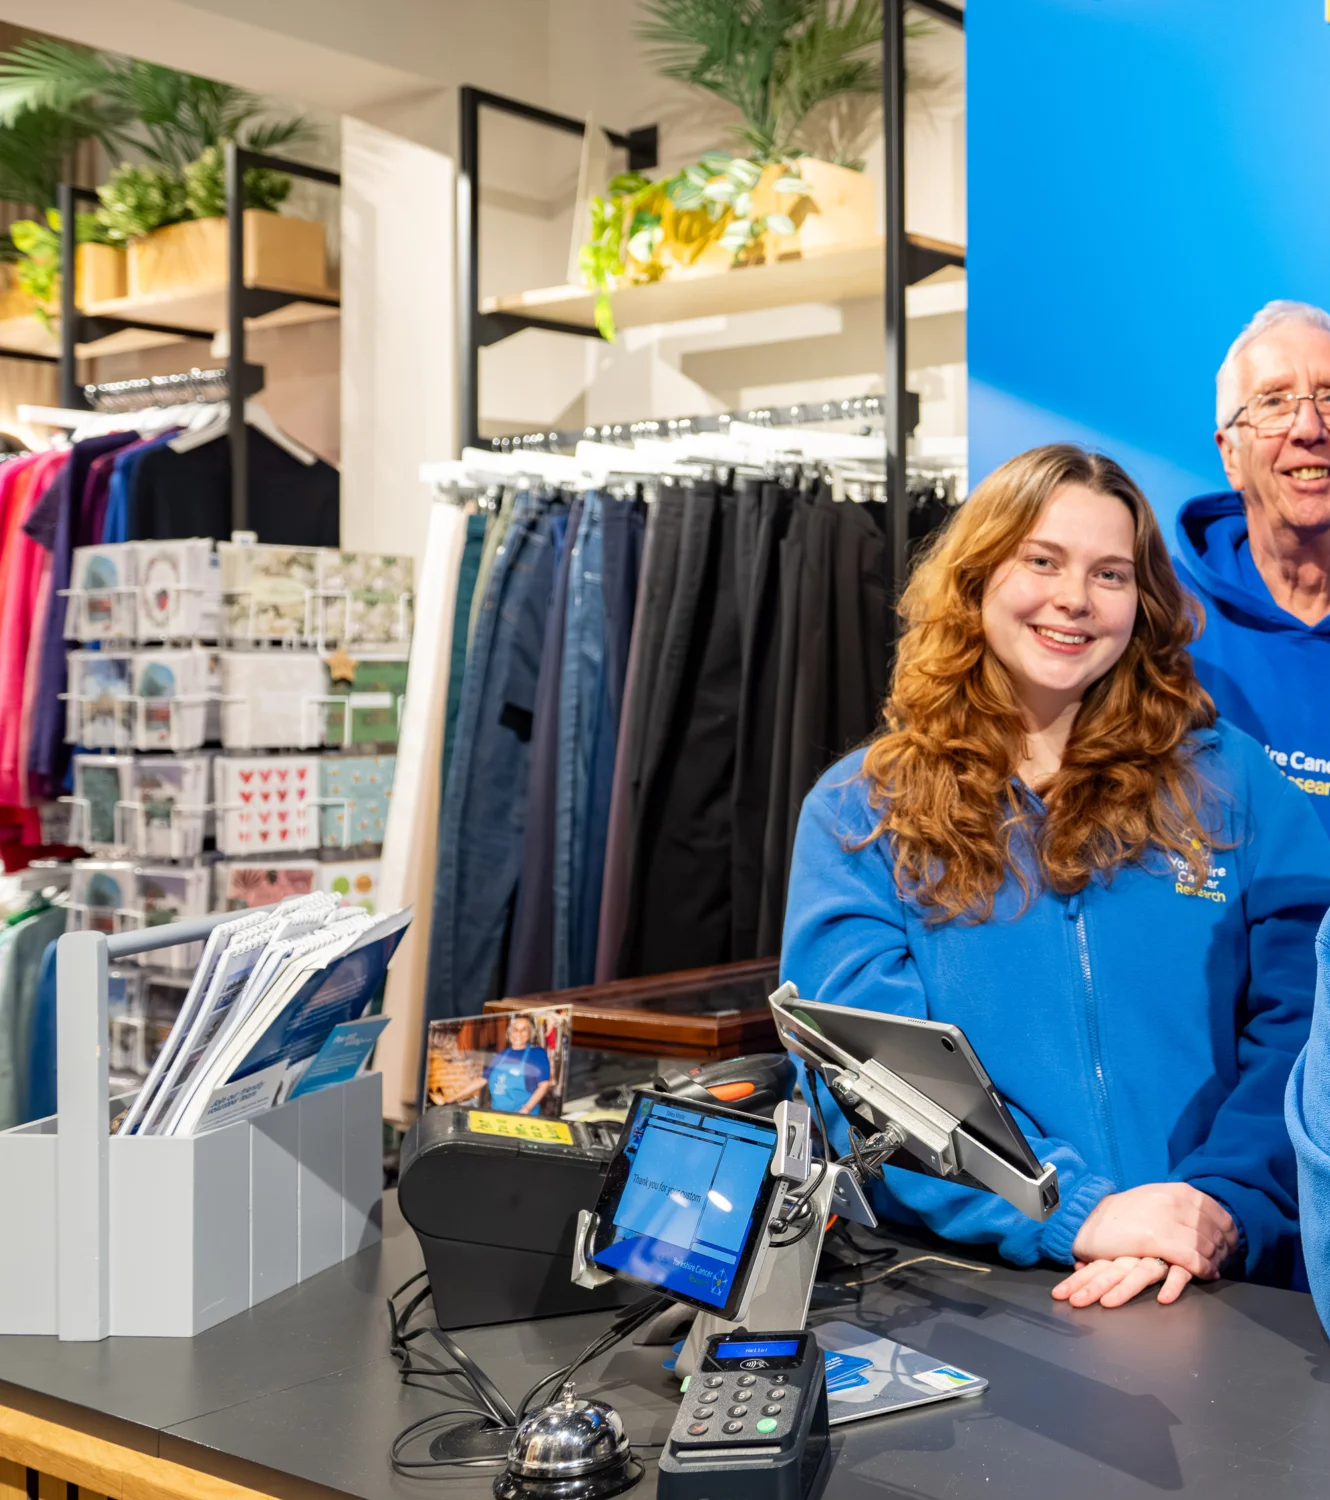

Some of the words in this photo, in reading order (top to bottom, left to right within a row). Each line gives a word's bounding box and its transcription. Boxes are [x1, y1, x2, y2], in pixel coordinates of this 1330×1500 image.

[632, 1173, 648, 1187] Thank
[648, 1180, 660, 1190] you
[659, 1181, 668, 1192] for
[681, 1190, 702, 1203] custom
[695, 1265, 713, 1278] Cancer
[738, 1391, 745, 1399] 5
[771, 1390, 779, 1398] 6
[733, 1407, 740, 1415] 8
